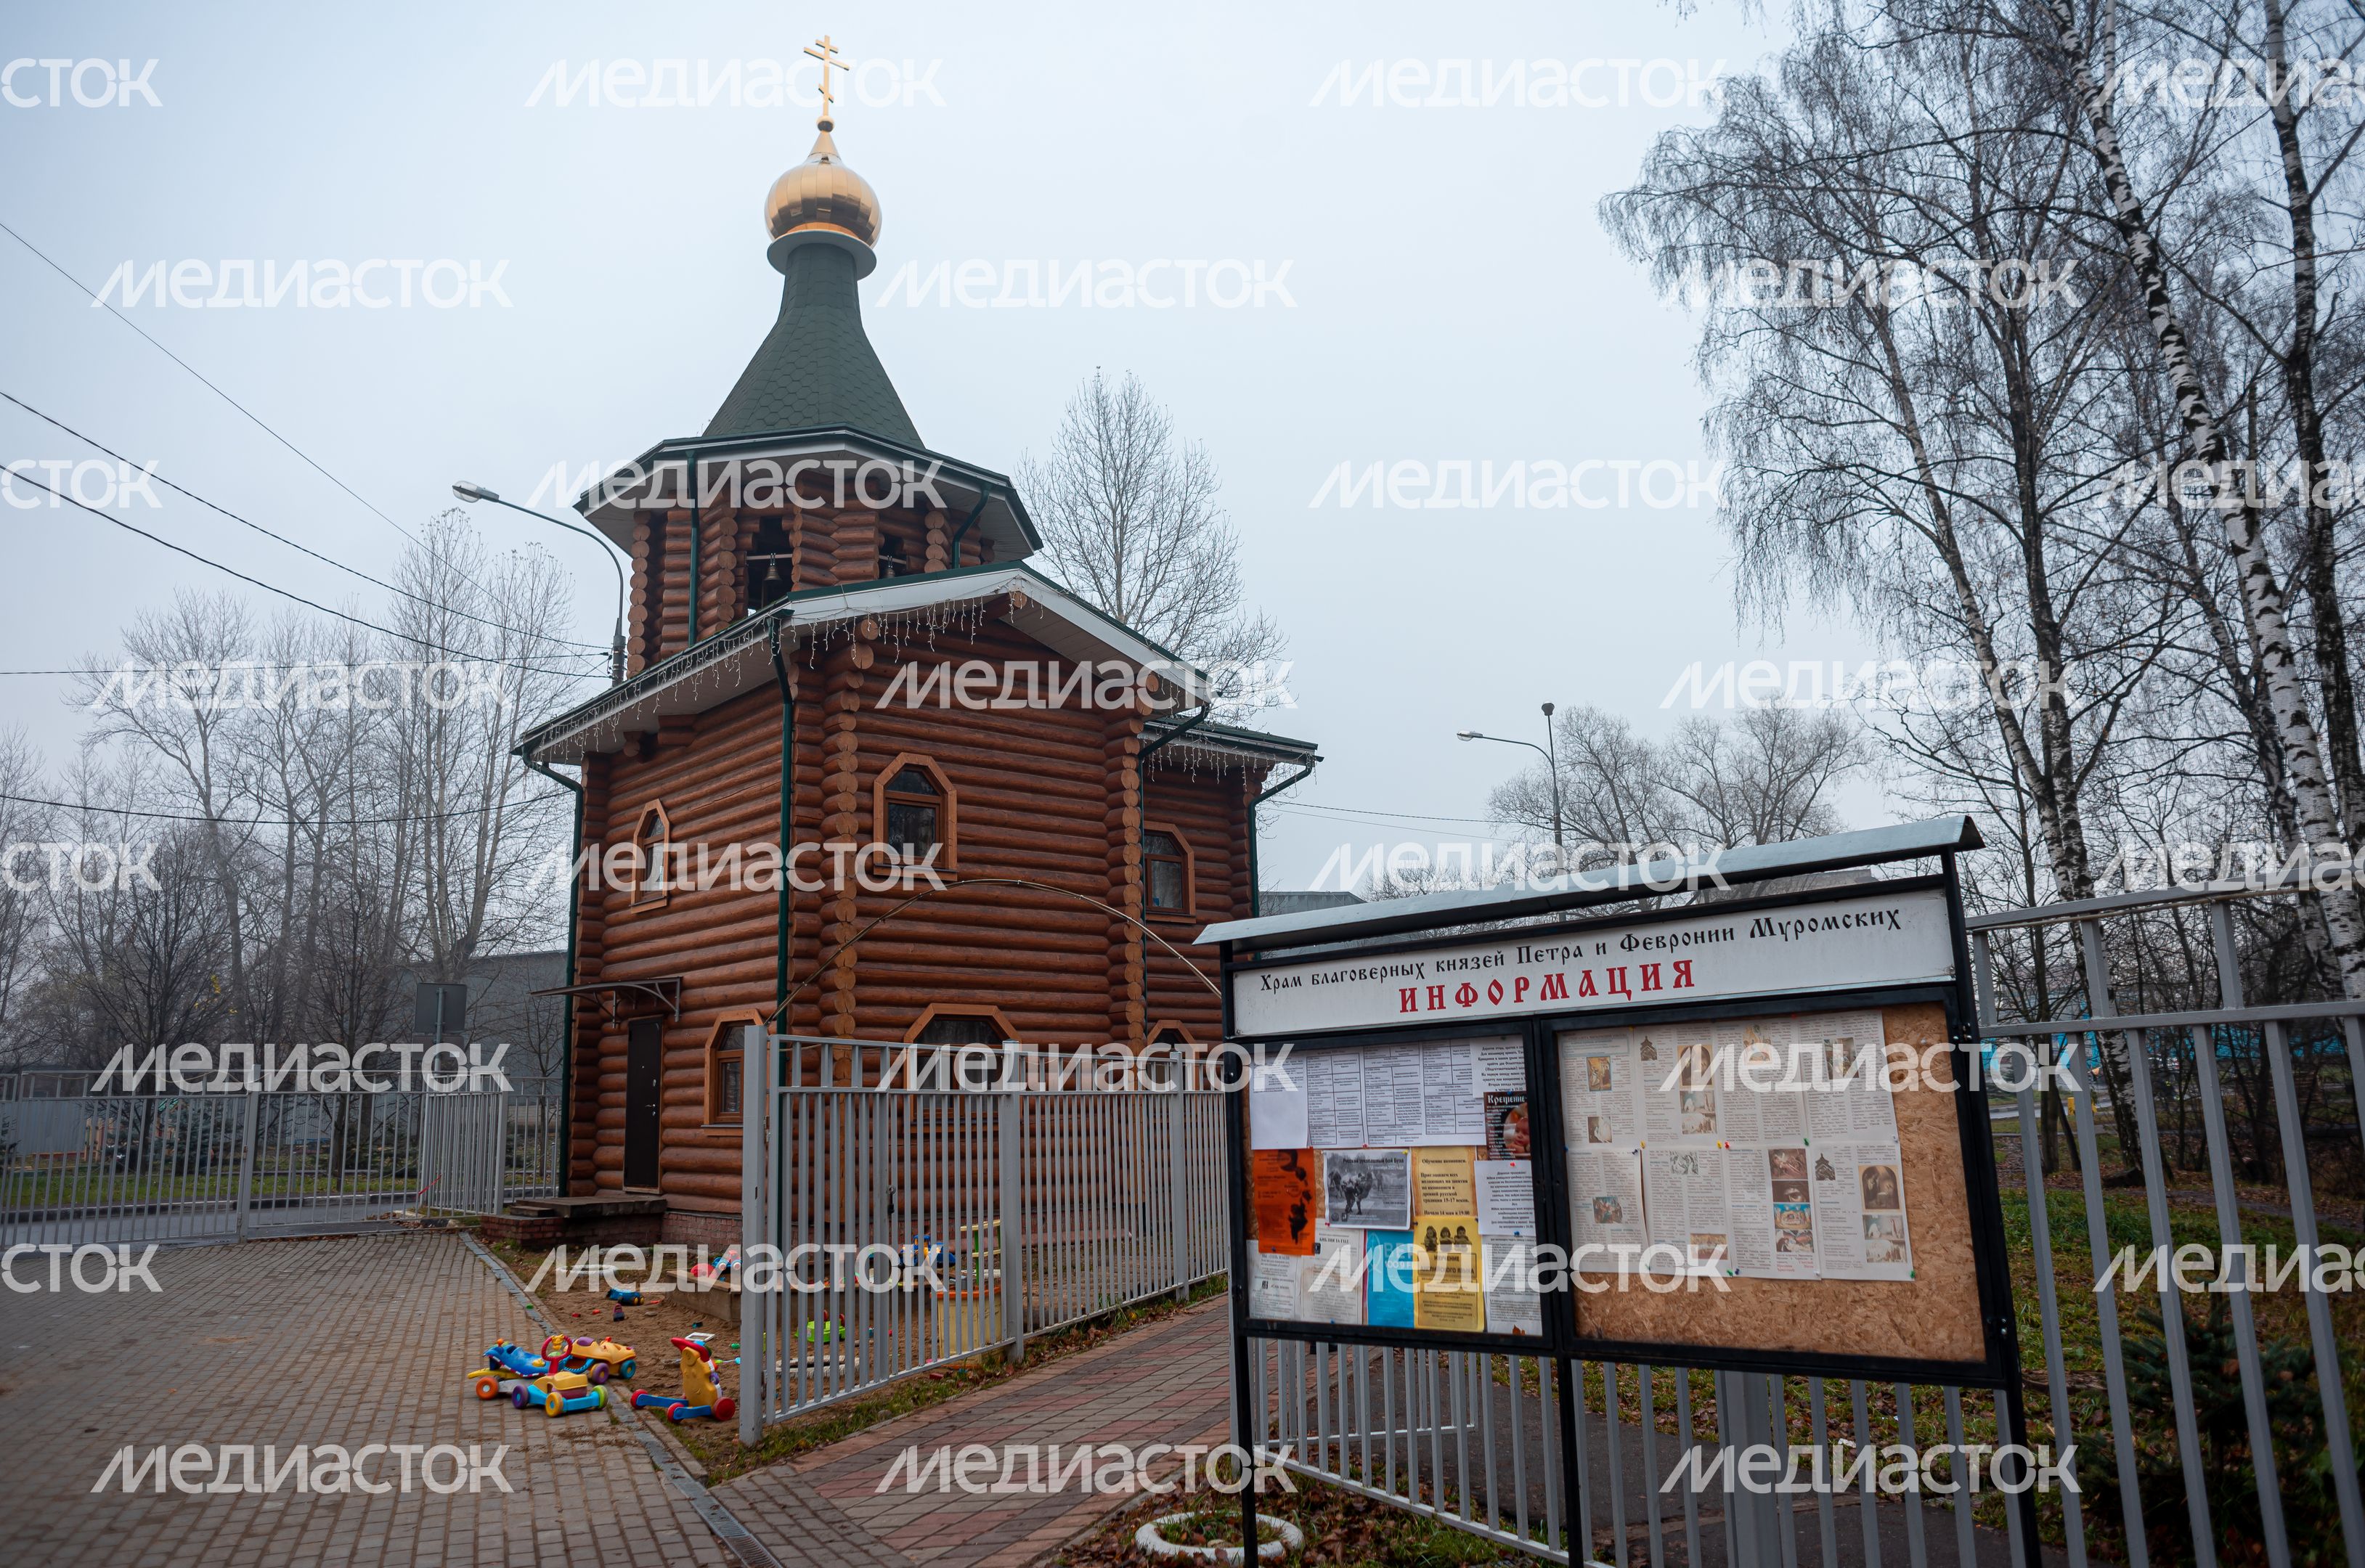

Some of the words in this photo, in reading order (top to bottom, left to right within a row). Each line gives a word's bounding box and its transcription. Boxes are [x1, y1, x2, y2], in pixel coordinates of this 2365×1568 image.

[1260, 973, 1302, 995] Храм
[1311, 963, 1425, 985] благоверных
[1436, 950, 1505, 973] князей
[1516, 945, 1584, 965] Петра
[1596, 942, 1607, 955] и
[1619, 927, 1735, 953] Февронии
[1749, 909, 1901, 942] Муромских
[1399, 959, 1695, 1013] ИНФОРМАЦИЯ
